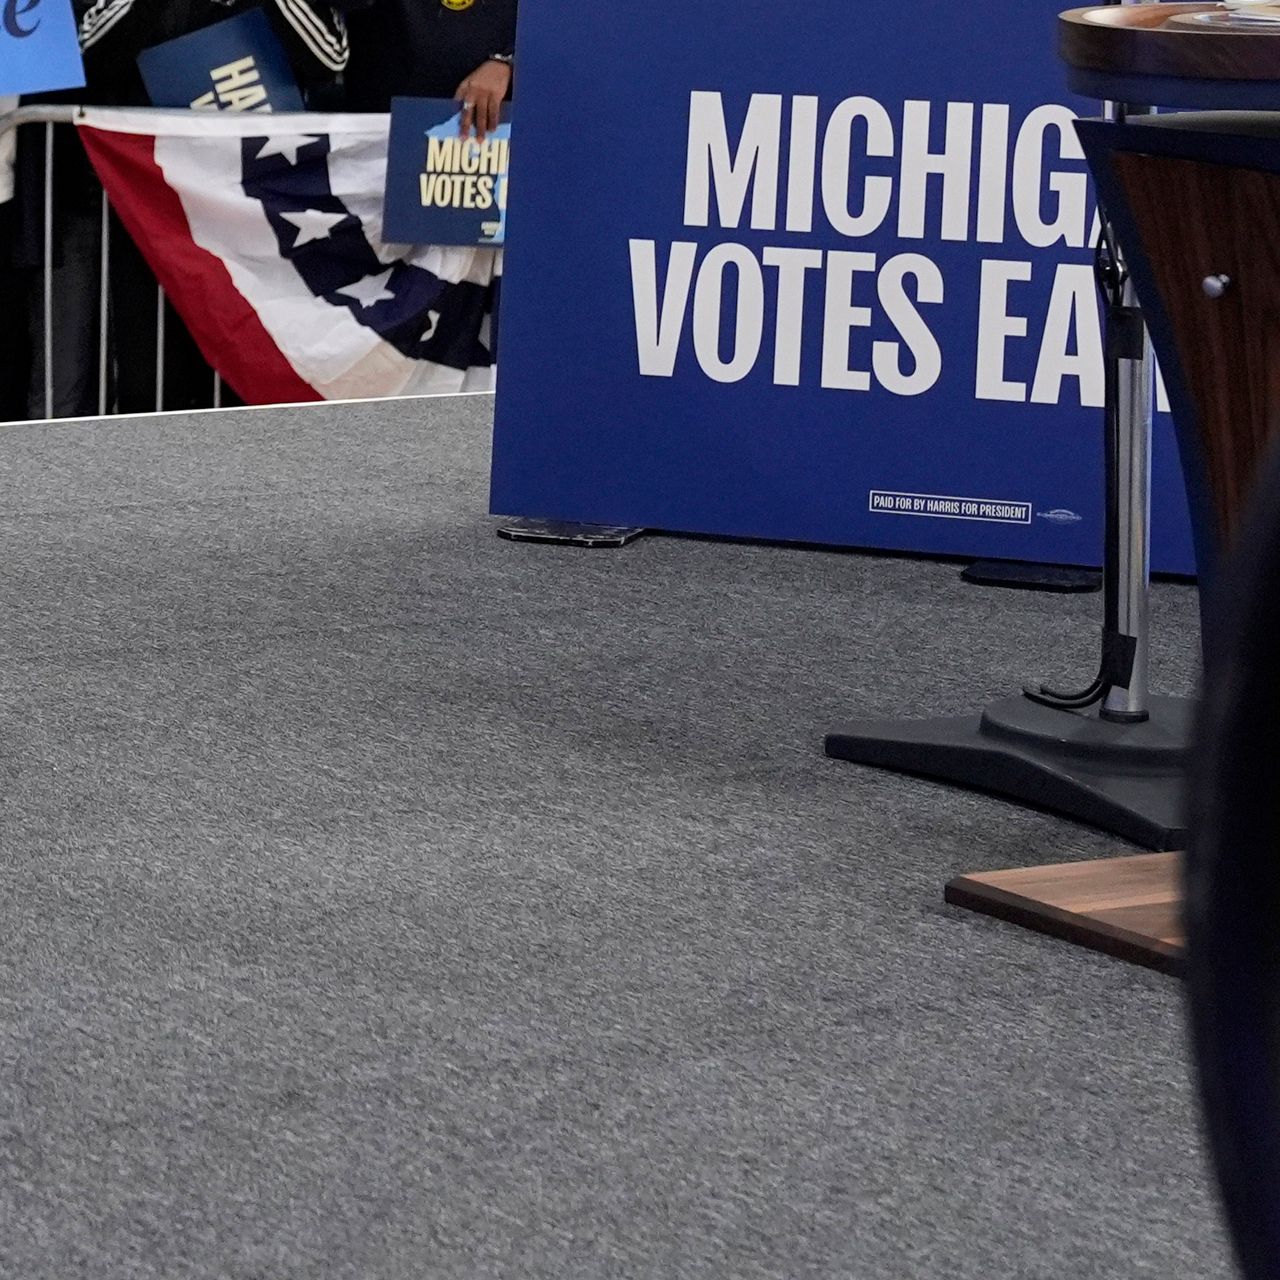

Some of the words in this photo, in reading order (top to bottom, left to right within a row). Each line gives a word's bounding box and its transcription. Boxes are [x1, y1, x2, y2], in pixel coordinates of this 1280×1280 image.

[419, 173, 494, 210] VOTES
[682, 90, 1106, 249] MICHIG
[628, 237, 944, 397] VOTES
[873, 495, 894, 508] PAID
[895, 496, 912, 510] FOR
[914, 497, 926, 511] BY
[927, 499, 960, 514] HARRIS
[961, 501, 978, 515] FOR
[979, 503, 1028, 520] PRESIDENT
